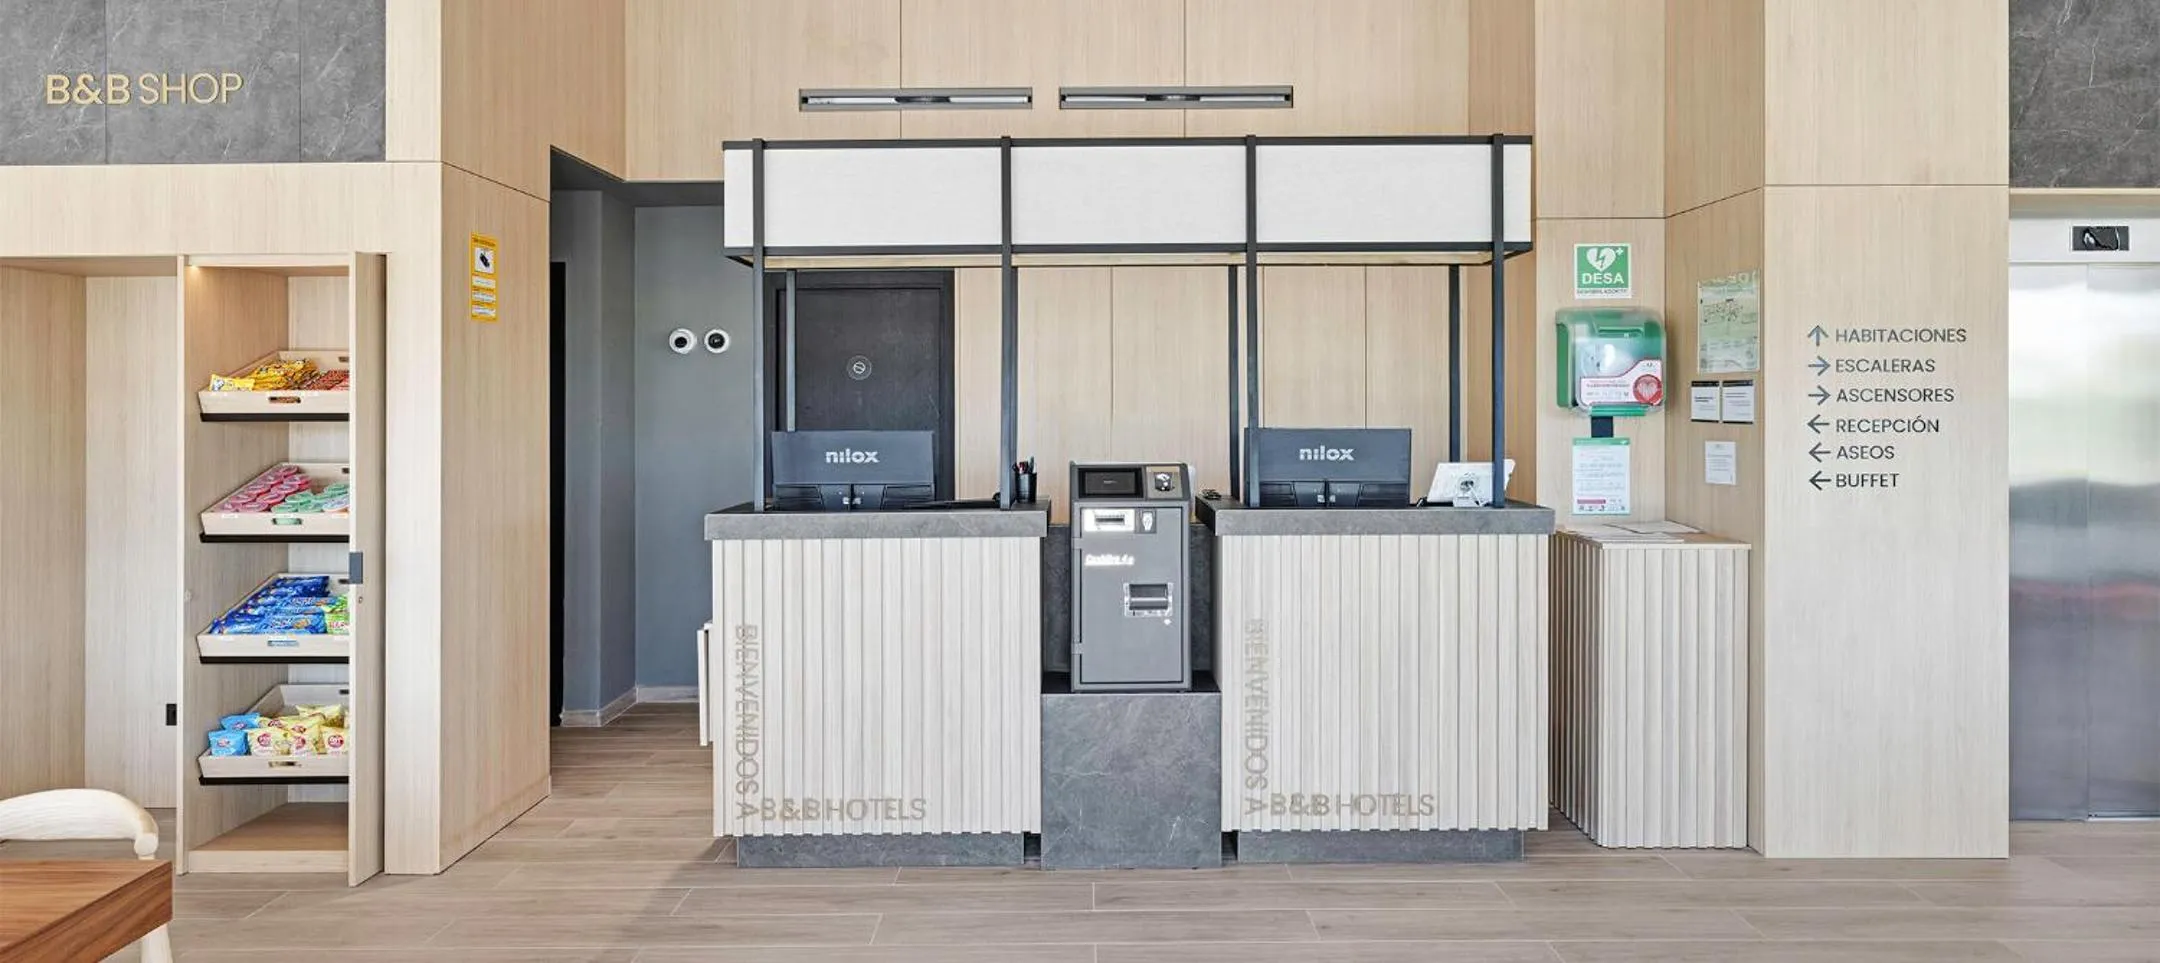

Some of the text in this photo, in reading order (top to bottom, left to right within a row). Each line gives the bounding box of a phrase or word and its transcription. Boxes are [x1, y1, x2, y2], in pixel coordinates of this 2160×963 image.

[46, 72, 244, 105] B&B SHOP
[1581, 272, 1625, 285] DESA
[1835, 328, 1967, 343] HABITACIONES
[1835, 358, 1936, 373] ESCALERAS
[1836, 388, 1955, 402] ASCENSORES
[1836, 415, 1940, 433] RECEPCIÓN
[825, 448, 879, 464] nilox
[1299, 445, 1354, 461] nilox
[1836, 445, 1895, 460] ASEOS
[1835, 473, 1900, 488] BUFFET
[735, 624, 760, 821] BIENVENIDOS A
[1244, 618, 1269, 816] BIENVENIDOS A
[760, 797, 927, 822] B&B HOTELS
[1270, 793, 1436, 817] B&B HOTELS
